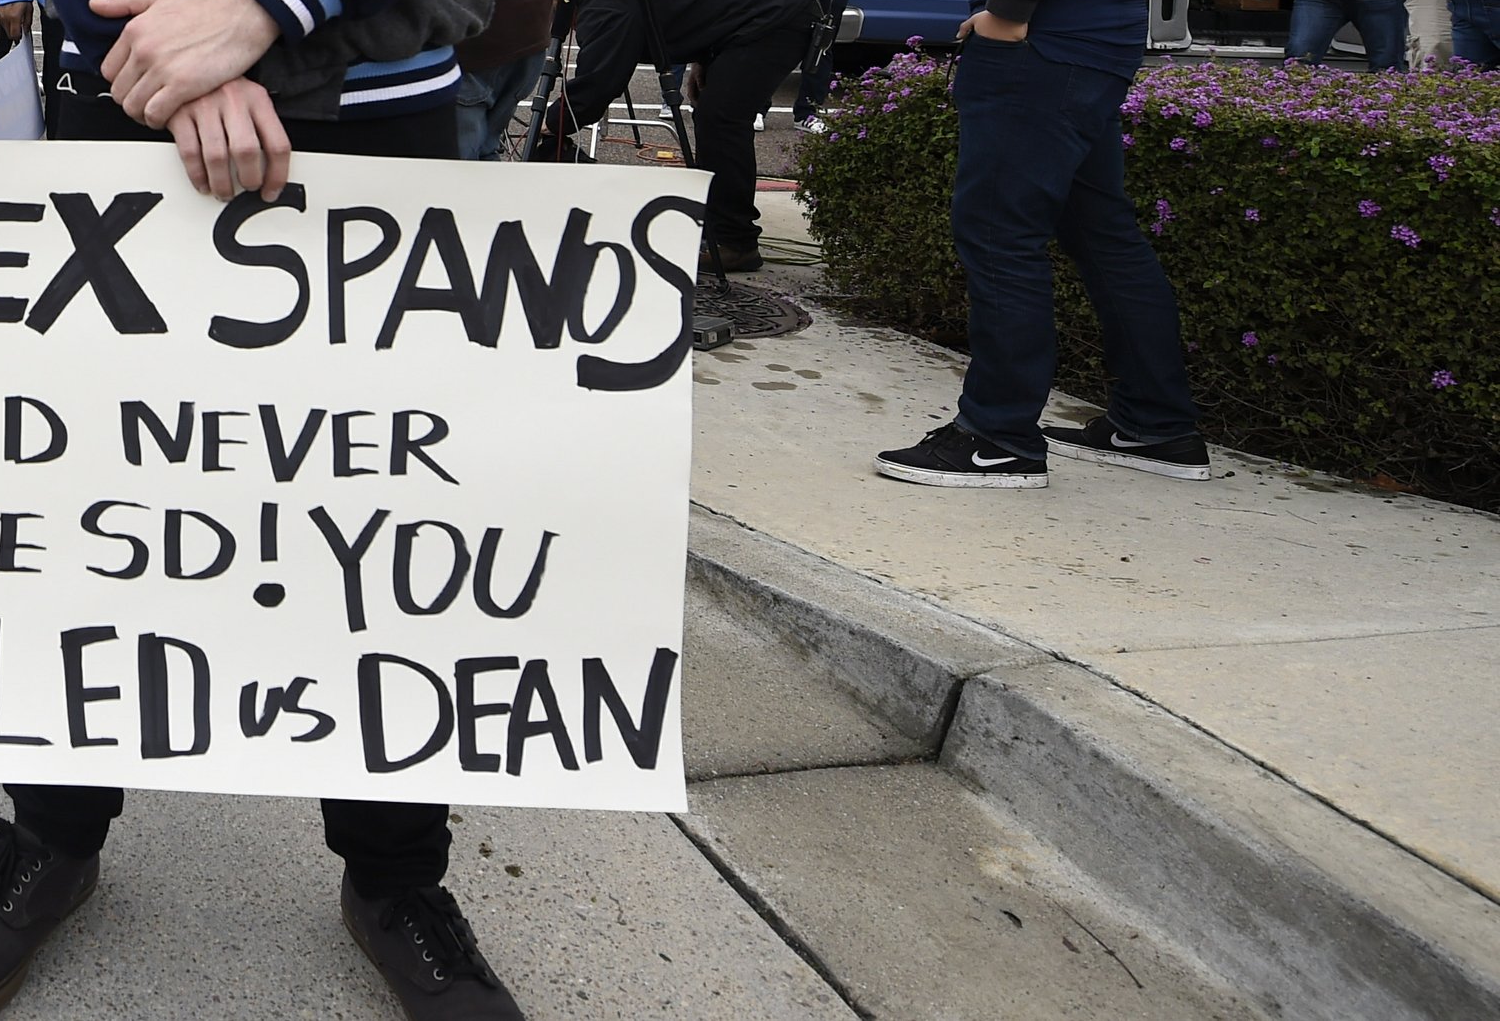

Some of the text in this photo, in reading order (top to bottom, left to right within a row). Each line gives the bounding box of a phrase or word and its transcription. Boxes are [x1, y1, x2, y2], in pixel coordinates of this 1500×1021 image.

[209, 182, 704, 392] SPANOS
[120, 401, 460, 486] NEVER
[238, 676, 336, 743] us
[357, 648, 679, 776] DEAN
